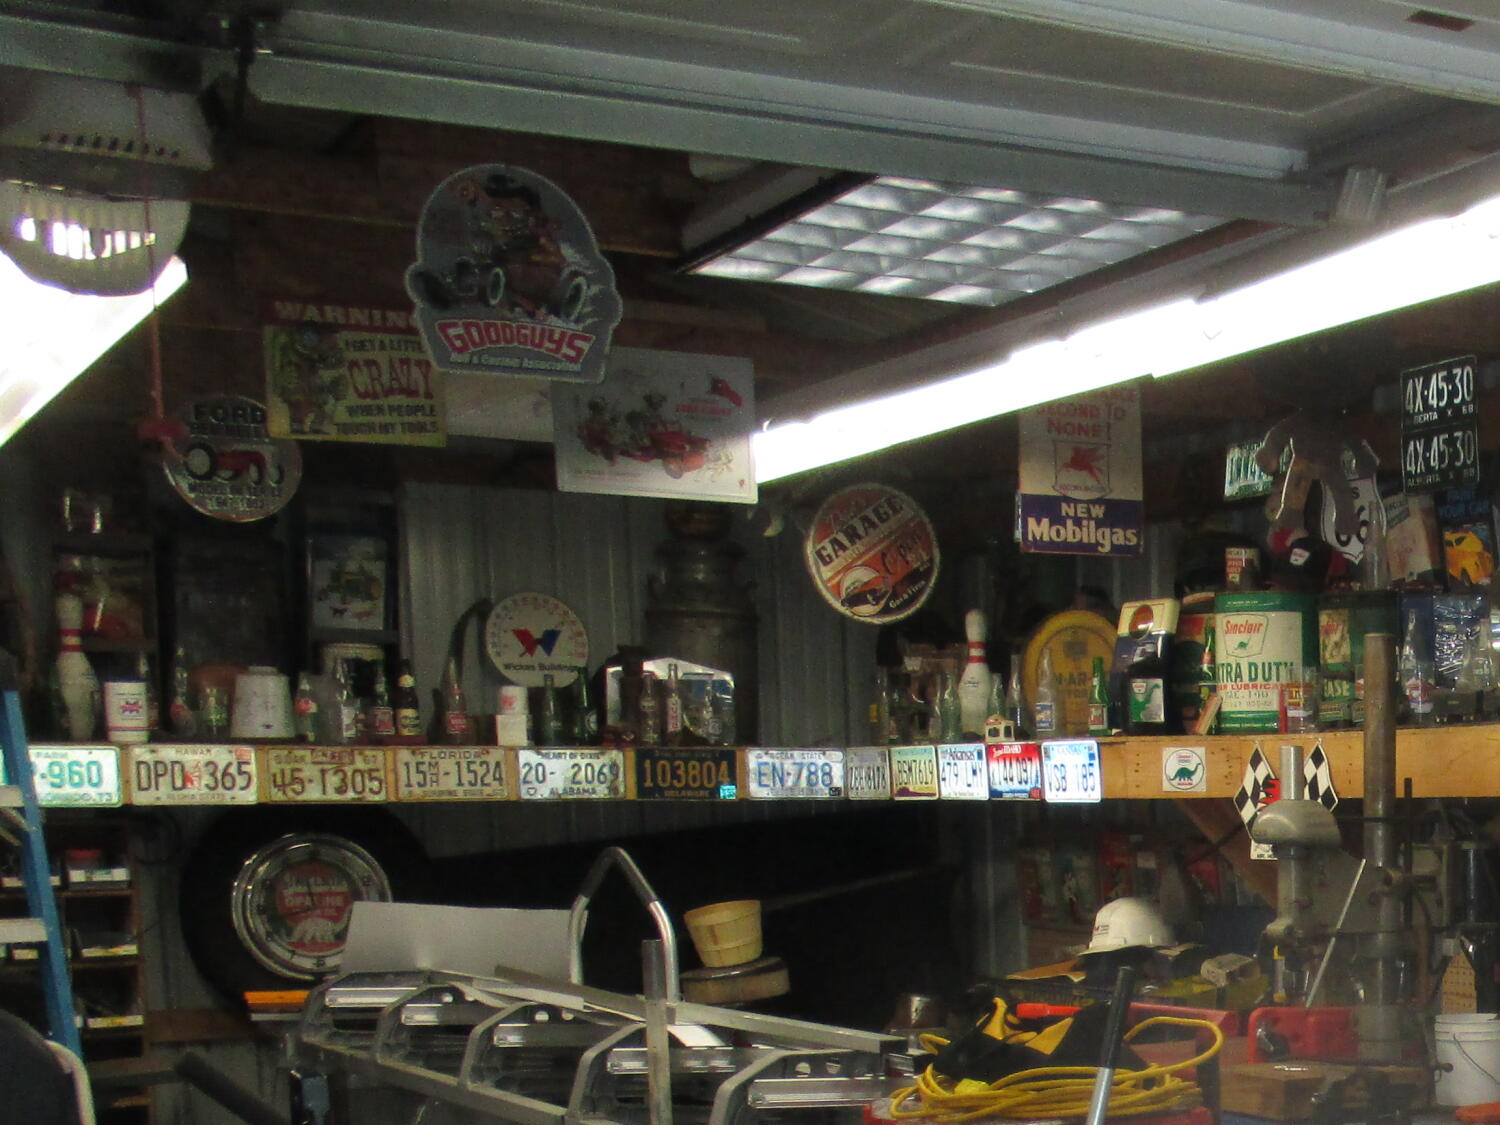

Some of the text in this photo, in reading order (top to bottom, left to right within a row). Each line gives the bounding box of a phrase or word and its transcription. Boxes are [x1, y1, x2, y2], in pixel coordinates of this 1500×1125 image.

[274, 301, 417, 329] WARNIN
[437, 320, 596, 364] GOODGUYS
[348, 358, 434, 400] CRAZY
[193, 404, 267, 424] FORD
[388, 404, 437, 418] PEOPLE
[1061, 503, 1106, 518] NEW
[815, 496, 903, 567] GARAGE
[1026, 517, 1139, 552] Mobilgas
[1223, 620, 1264, 636] Sinclair
[1215, 663, 1244, 683] XTRA
[420, 750, 484, 760] FLORIDA
[947, 749, 976, 761] Arkansas
[136, 760, 253, 791] DPD 365
[571, 762, 621, 785] 2069
[642, 760, 731, 789] 103804
[550, 787, 597, 797] ALABAMA
